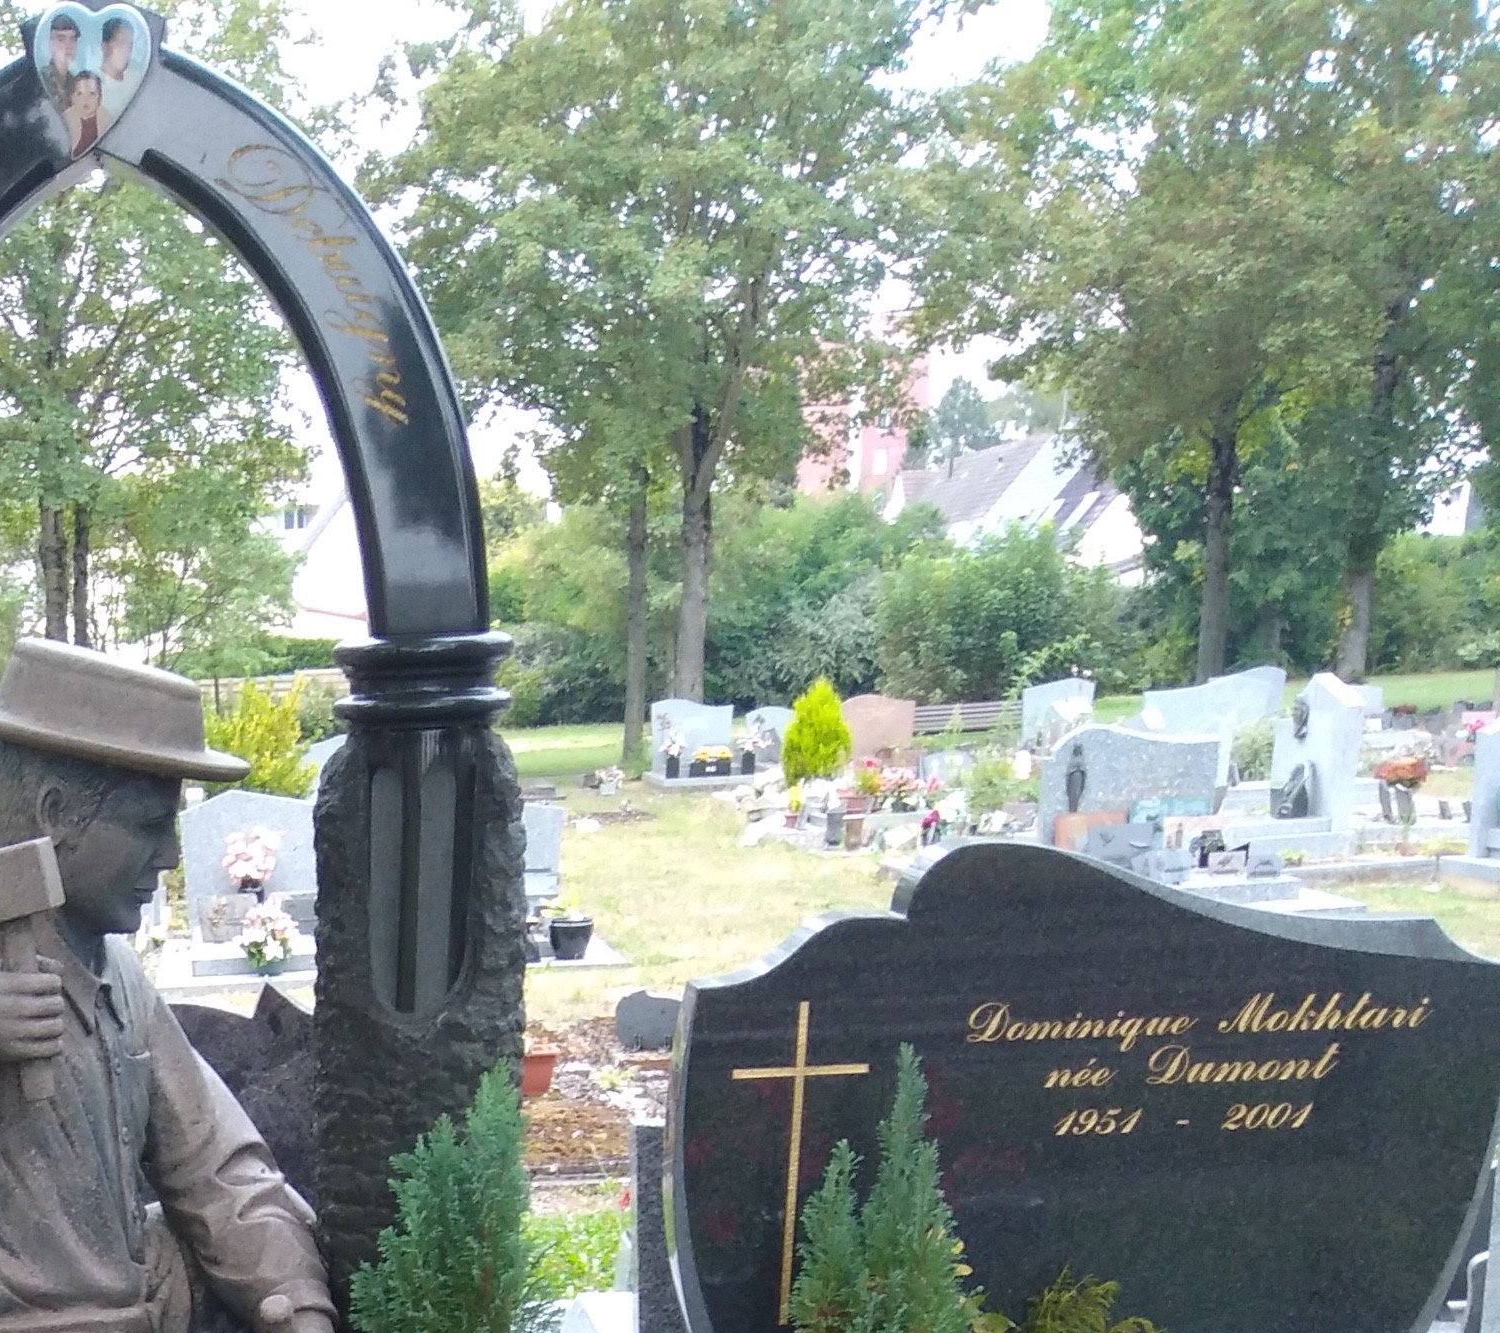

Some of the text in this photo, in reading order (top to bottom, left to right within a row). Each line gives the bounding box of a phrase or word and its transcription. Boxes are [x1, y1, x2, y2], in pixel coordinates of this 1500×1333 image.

[967, 993, 1434, 1052] Dominique Mokhtari
[1043, 1042, 1341, 1089] née Dumont
[1053, 1106, 1143, 1136] 1951
[1221, 1101, 1314, 1132] 2001
